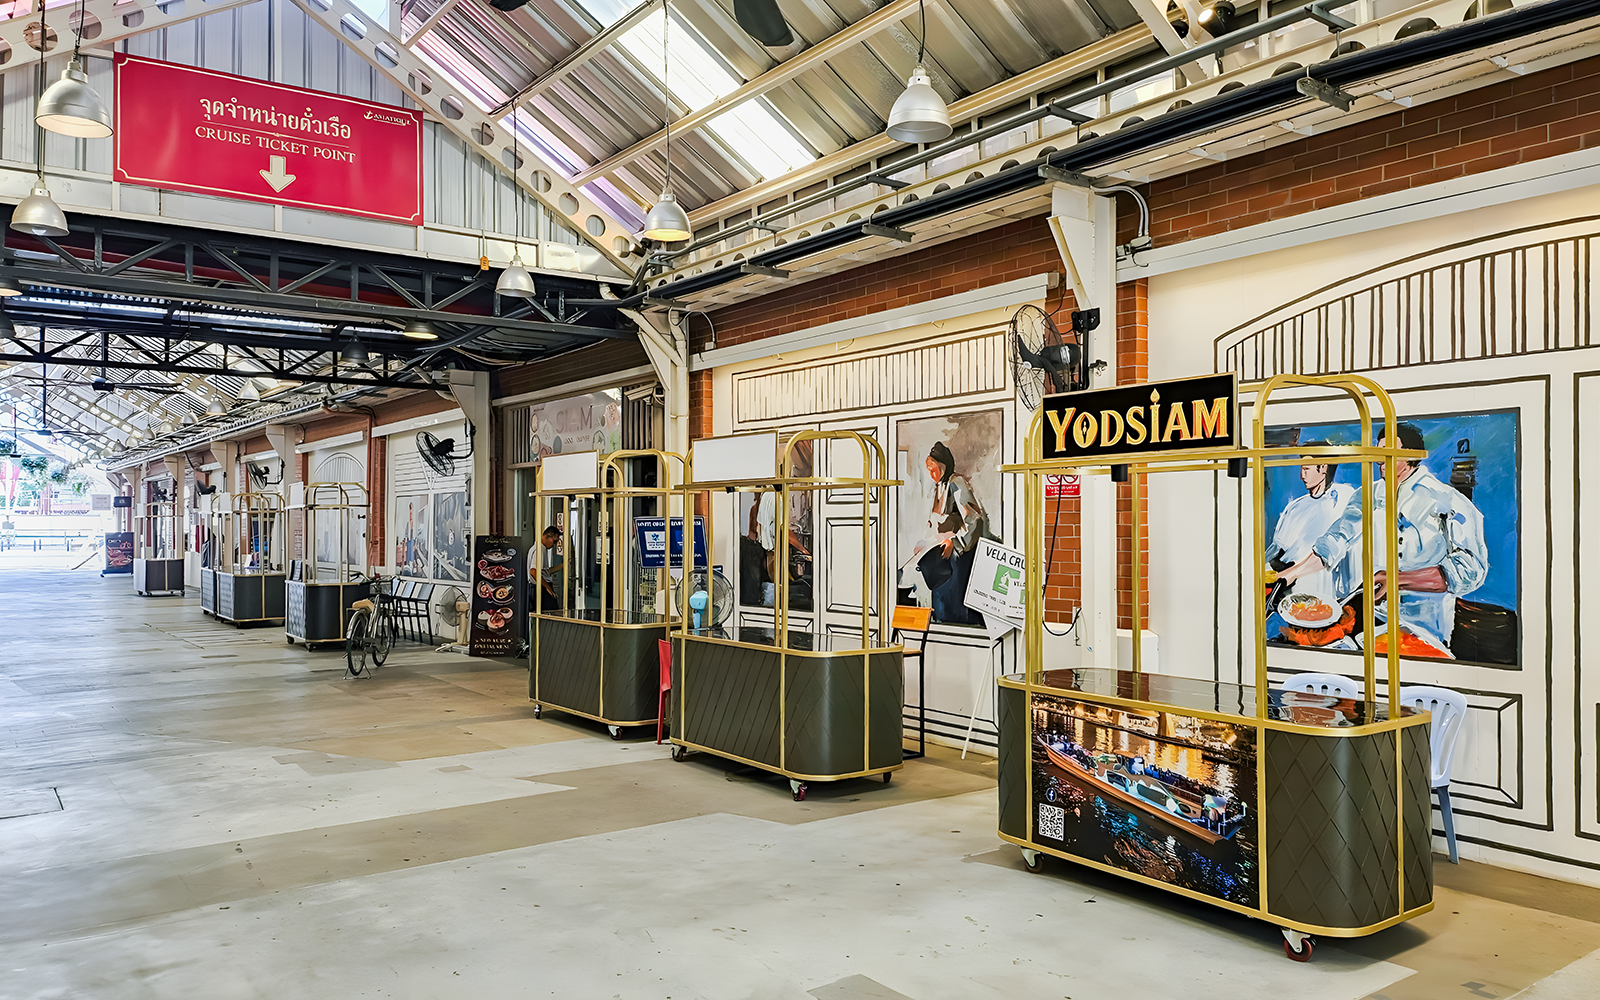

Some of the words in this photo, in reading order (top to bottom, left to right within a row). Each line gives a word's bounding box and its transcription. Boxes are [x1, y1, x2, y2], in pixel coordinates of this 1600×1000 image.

[195, 126, 251, 145] CRUISE
[256, 136, 309, 155] TICKET
[313, 147, 356, 163] POINT
[1045, 388, 1229, 452] YODSIAM
[986, 546, 1007, 563] VELA
